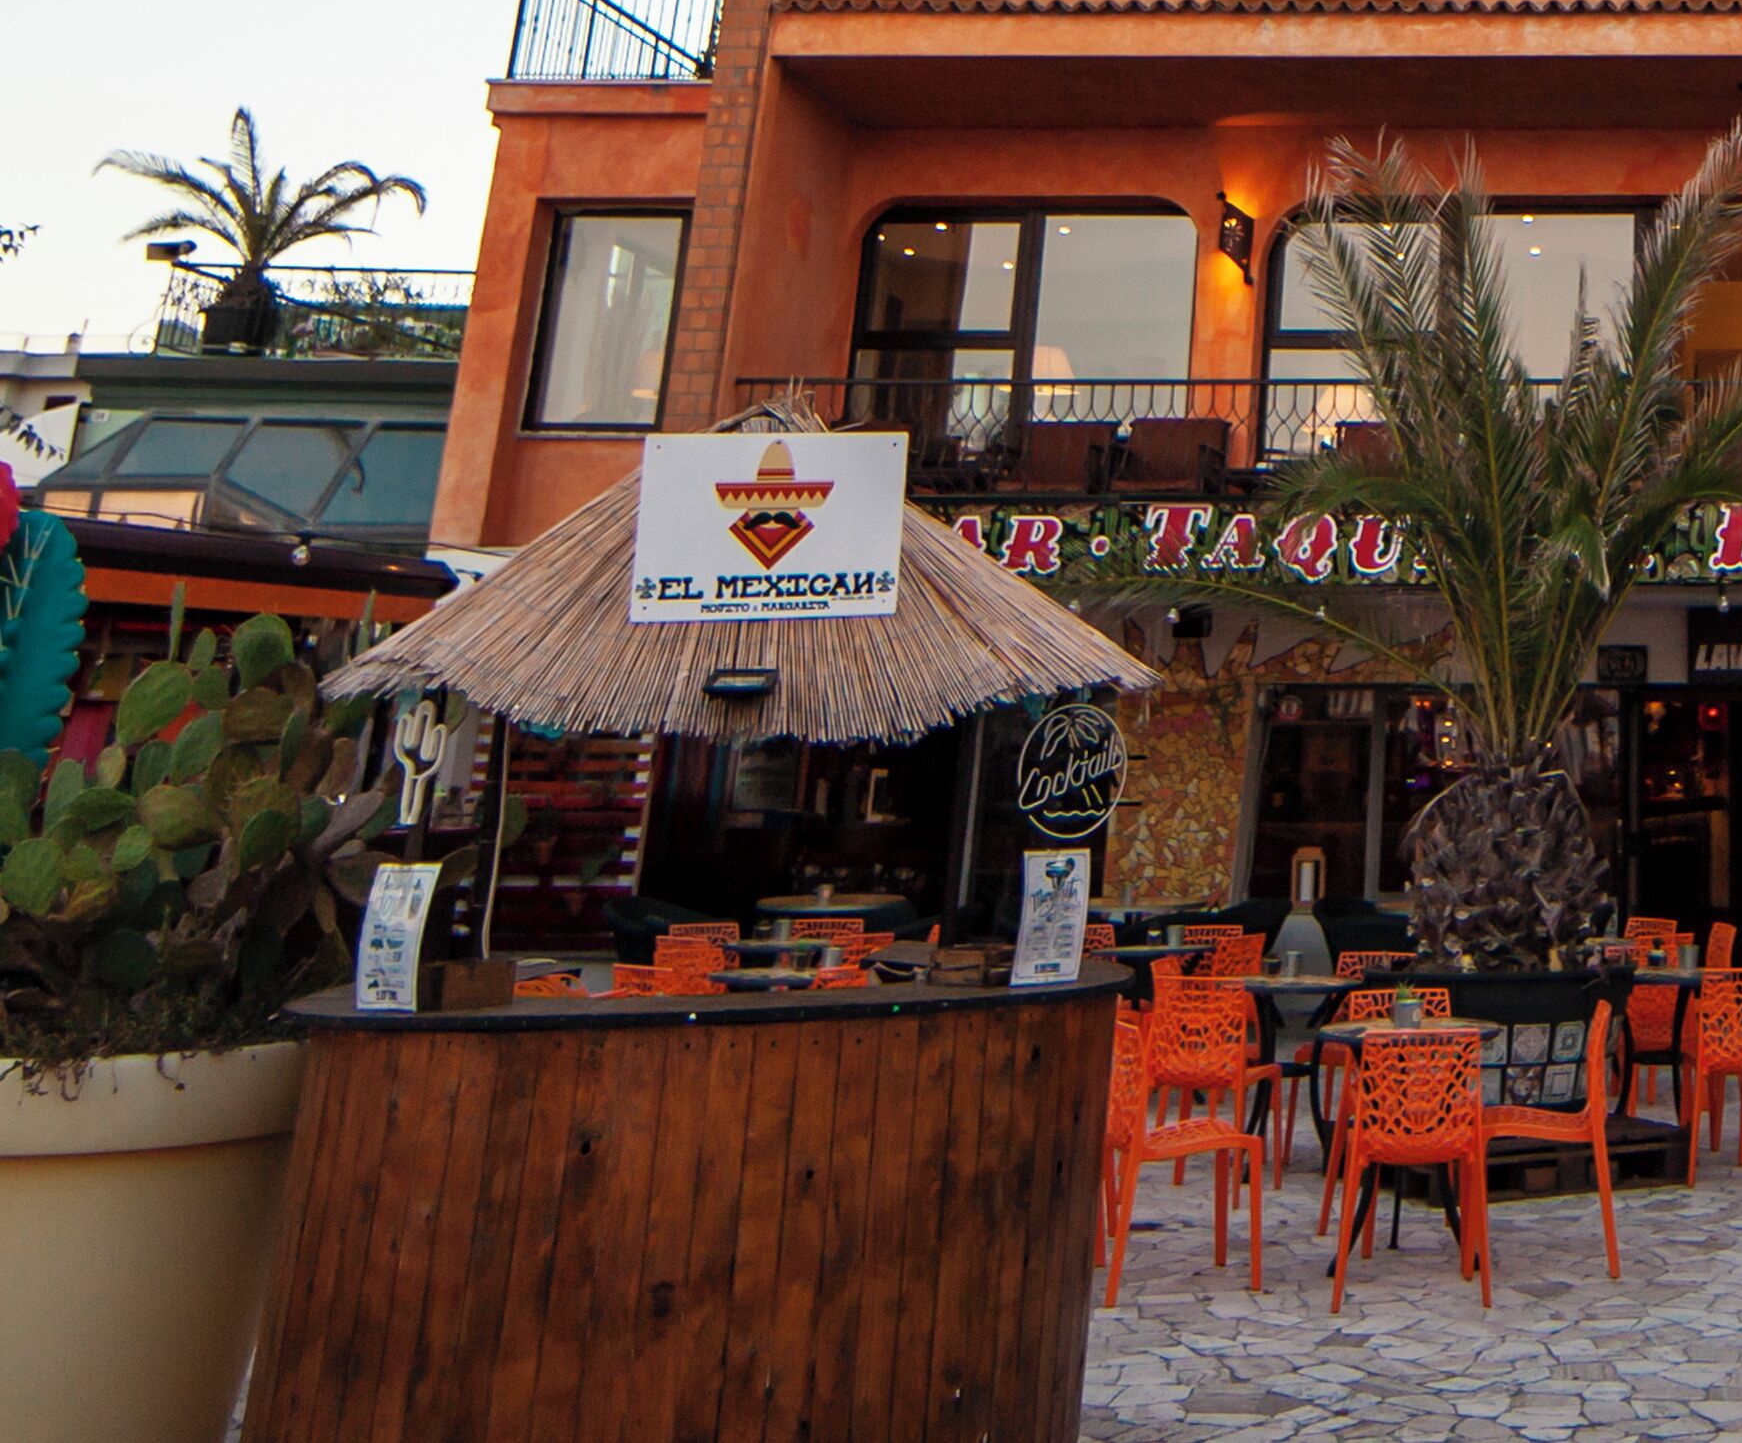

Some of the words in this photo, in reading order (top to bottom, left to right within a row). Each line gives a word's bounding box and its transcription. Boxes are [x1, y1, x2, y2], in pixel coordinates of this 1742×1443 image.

[657, 577, 704, 601] EL
[700, 603, 750, 614] MOJITO
[761, 600, 830, 612] MARGARITA
[1019, 733, 1124, 809] Cocktails
